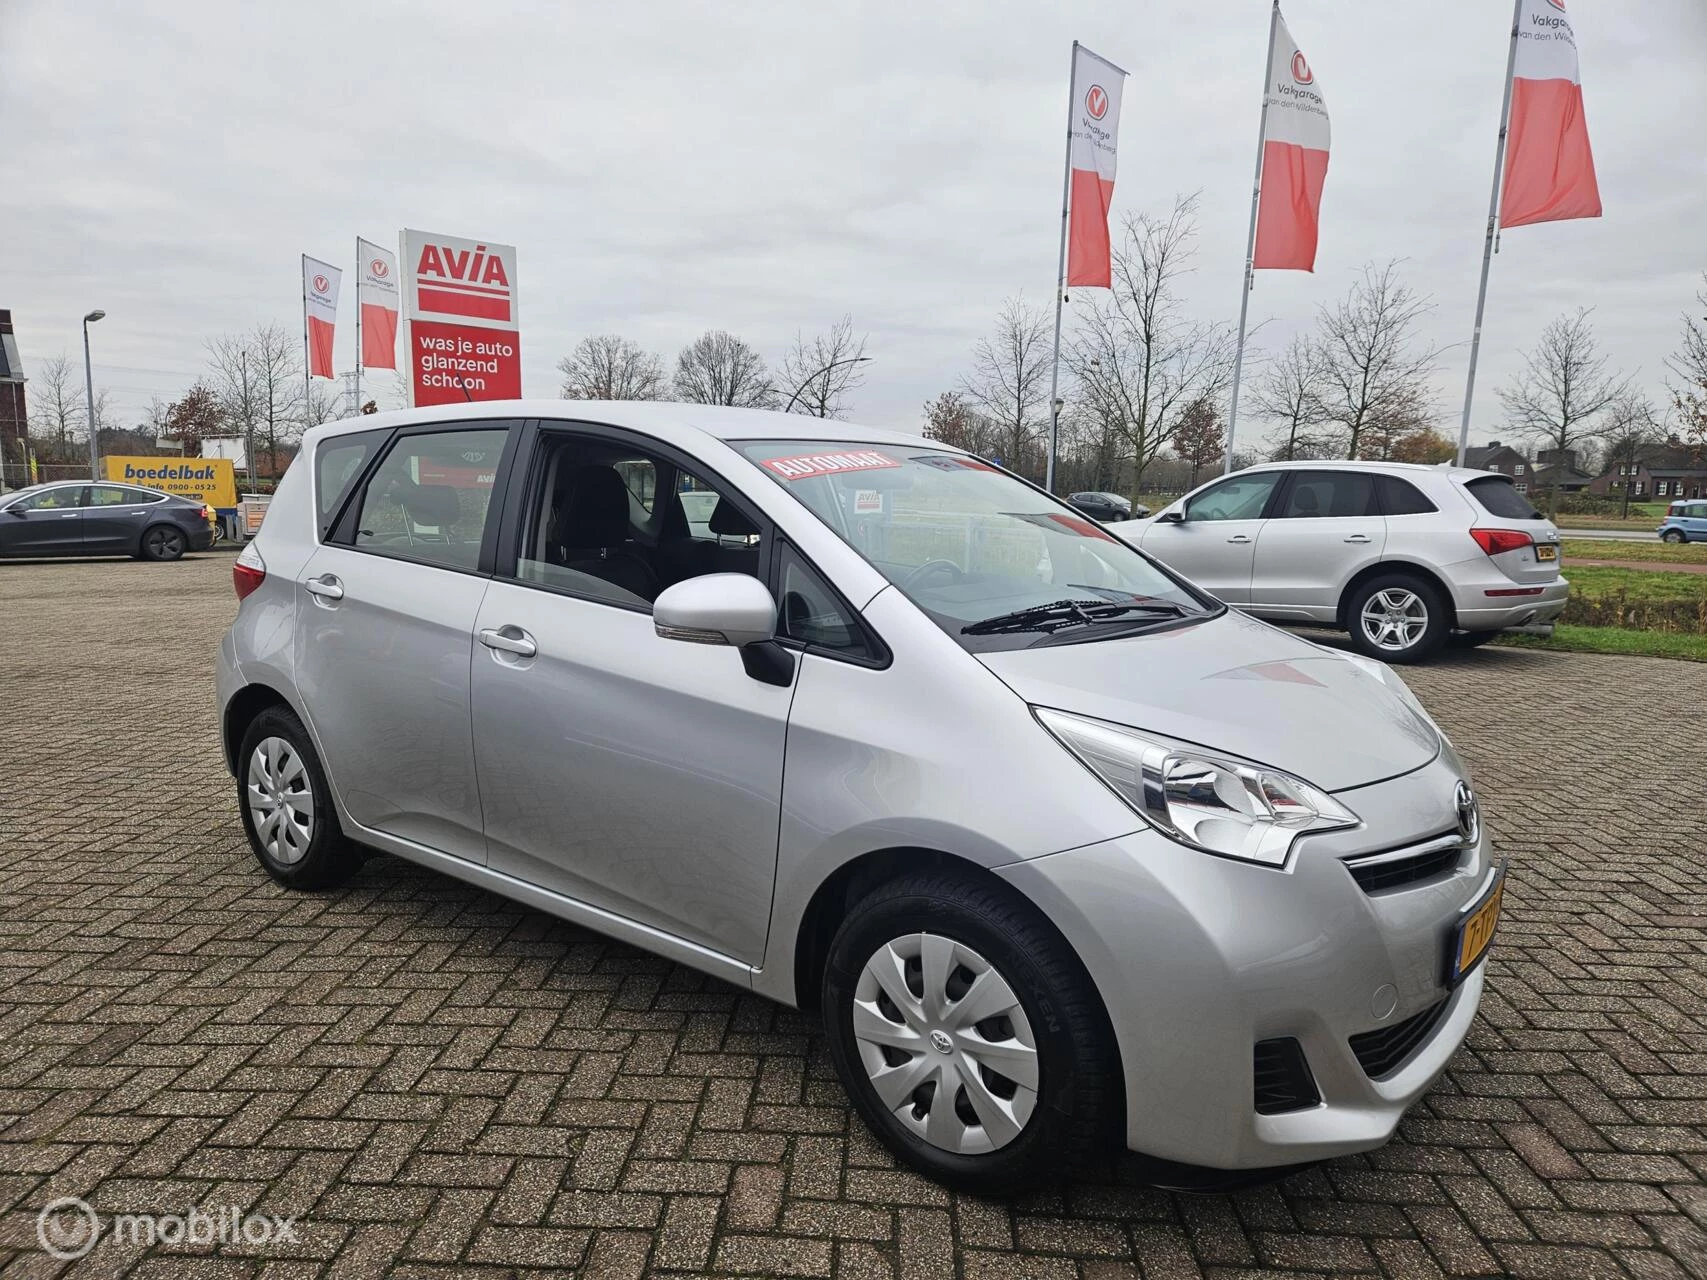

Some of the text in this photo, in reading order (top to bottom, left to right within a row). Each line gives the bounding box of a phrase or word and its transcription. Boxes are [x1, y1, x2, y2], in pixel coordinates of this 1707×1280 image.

[1534, 31, 1551, 41] den
[420, 336, 513, 357] was je auto
[421, 352, 498, 374] glanzend
[124, 463, 215, 480] boedelbak
[771, 451, 893, 477] AUTOMAAT
